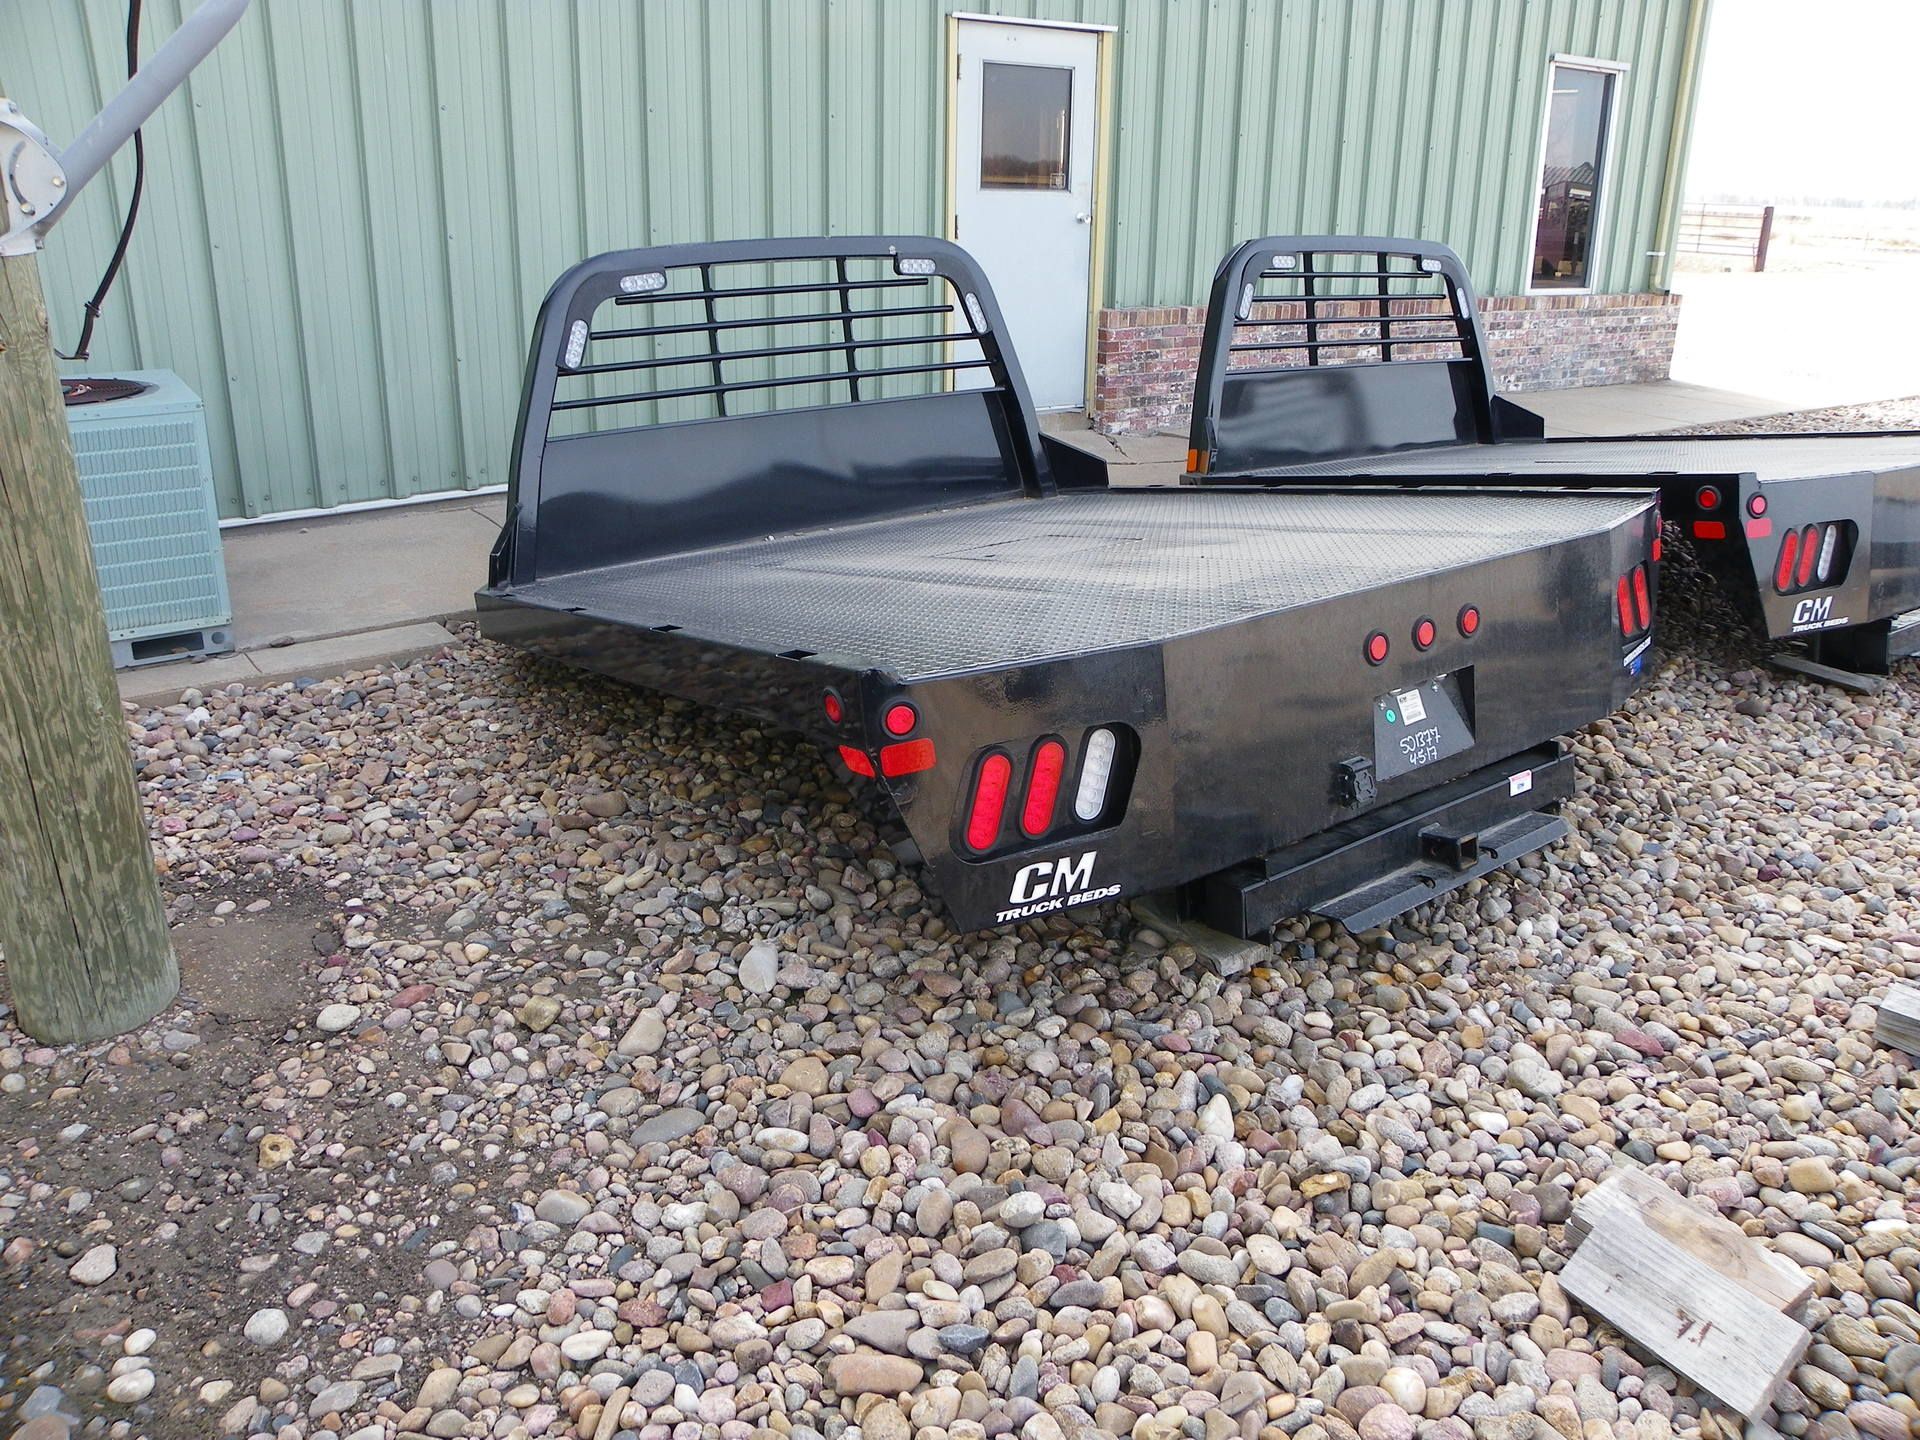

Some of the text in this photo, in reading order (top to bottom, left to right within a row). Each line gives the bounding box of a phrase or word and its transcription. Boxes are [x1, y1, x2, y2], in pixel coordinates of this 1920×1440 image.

[1792, 596, 1833, 624] CM
[1792, 621, 1823, 633] TRUCK
[1009, 851, 1097, 904] CM
[996, 884, 1122, 923] TRUCK BEDS
